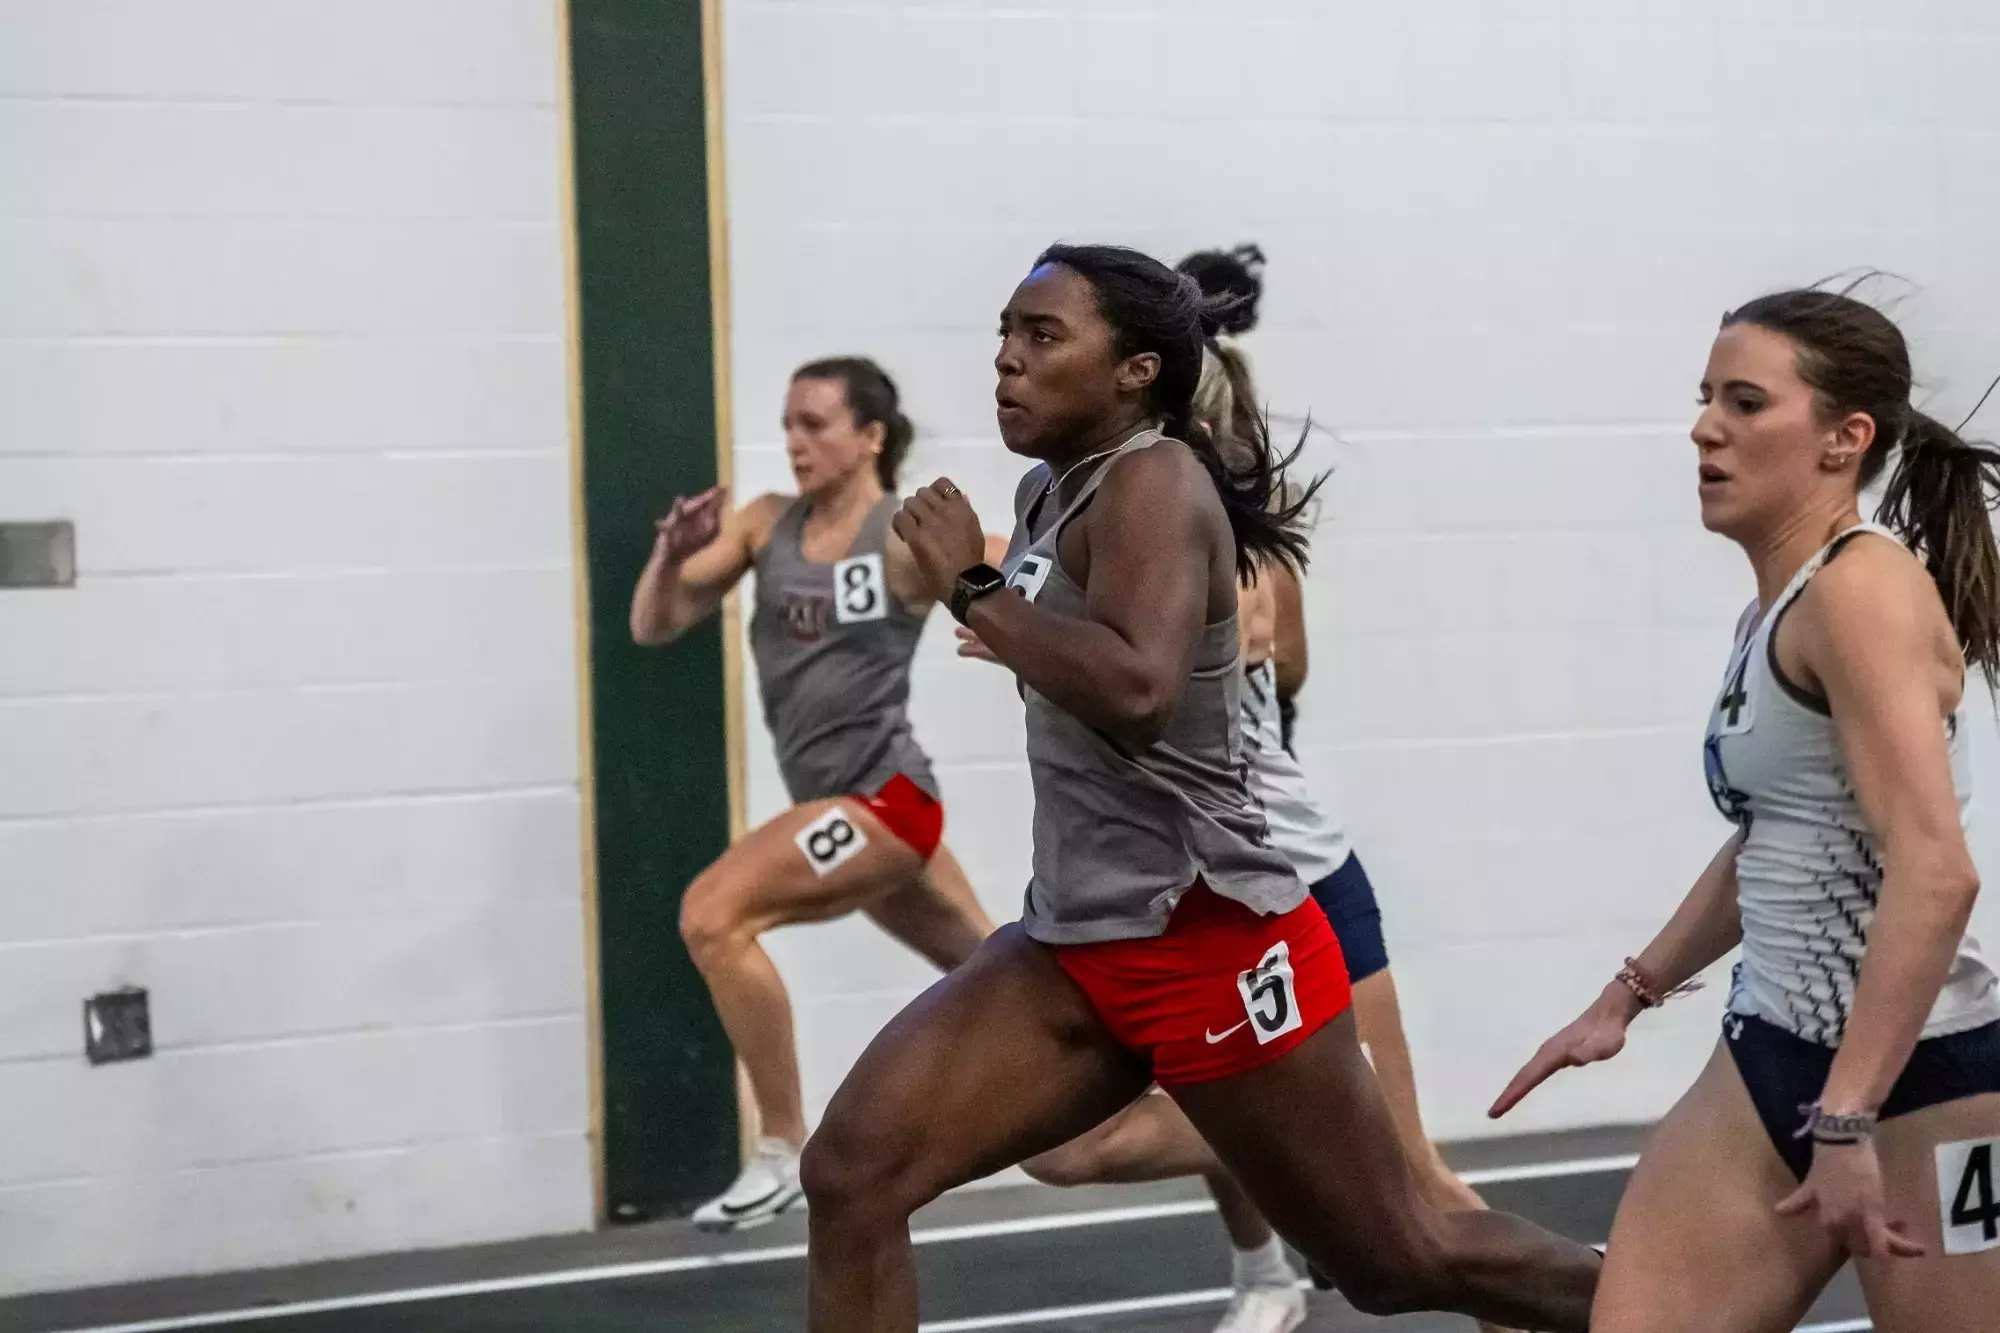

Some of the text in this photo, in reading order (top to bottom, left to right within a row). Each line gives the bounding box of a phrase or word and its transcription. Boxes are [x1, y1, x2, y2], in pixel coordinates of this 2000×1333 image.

[844, 563, 875, 613] 8
[1720, 647, 1748, 727] 4
[808, 818, 854, 861] 8
[1246, 953, 1288, 1032] 5
[1951, 1143, 2000, 1241] 4
